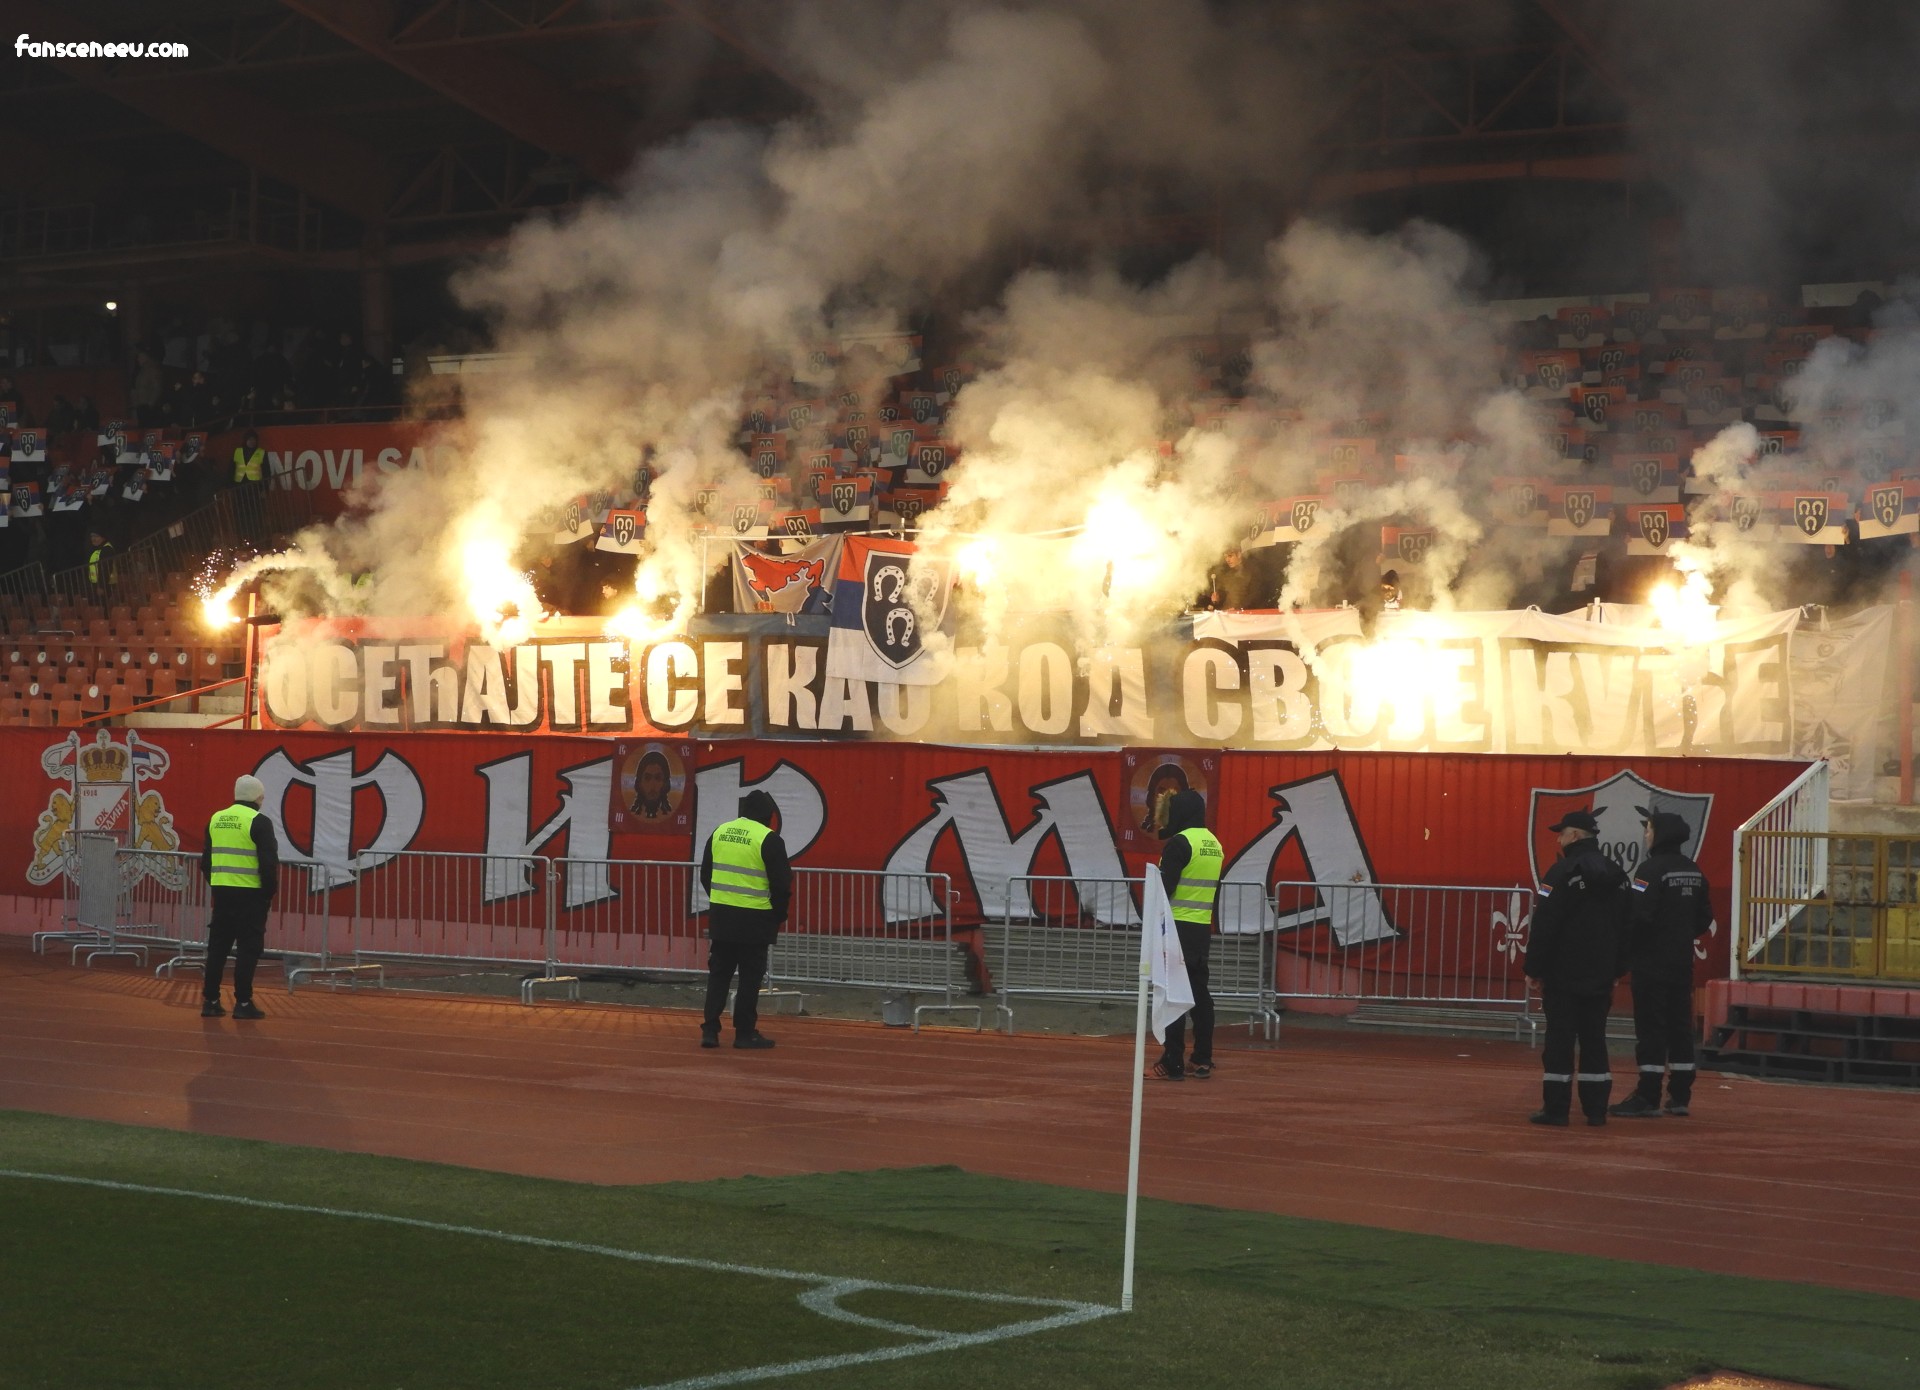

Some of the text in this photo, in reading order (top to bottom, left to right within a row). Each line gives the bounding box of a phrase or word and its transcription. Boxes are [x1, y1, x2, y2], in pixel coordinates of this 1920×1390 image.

[267, 449, 364, 491] NOVI
[264, 640, 628, 728] ОСЕЋАЈТЕ
[645, 640, 746, 727] СЕ
[767, 642, 931, 736] КАО
[956, 642, 1154, 739] КОД
[1183, 643, 1487, 745] СВОЈЕ
[254, 745, 1400, 948] ФИРМА
[726, 827, 750, 837] SECURITY
